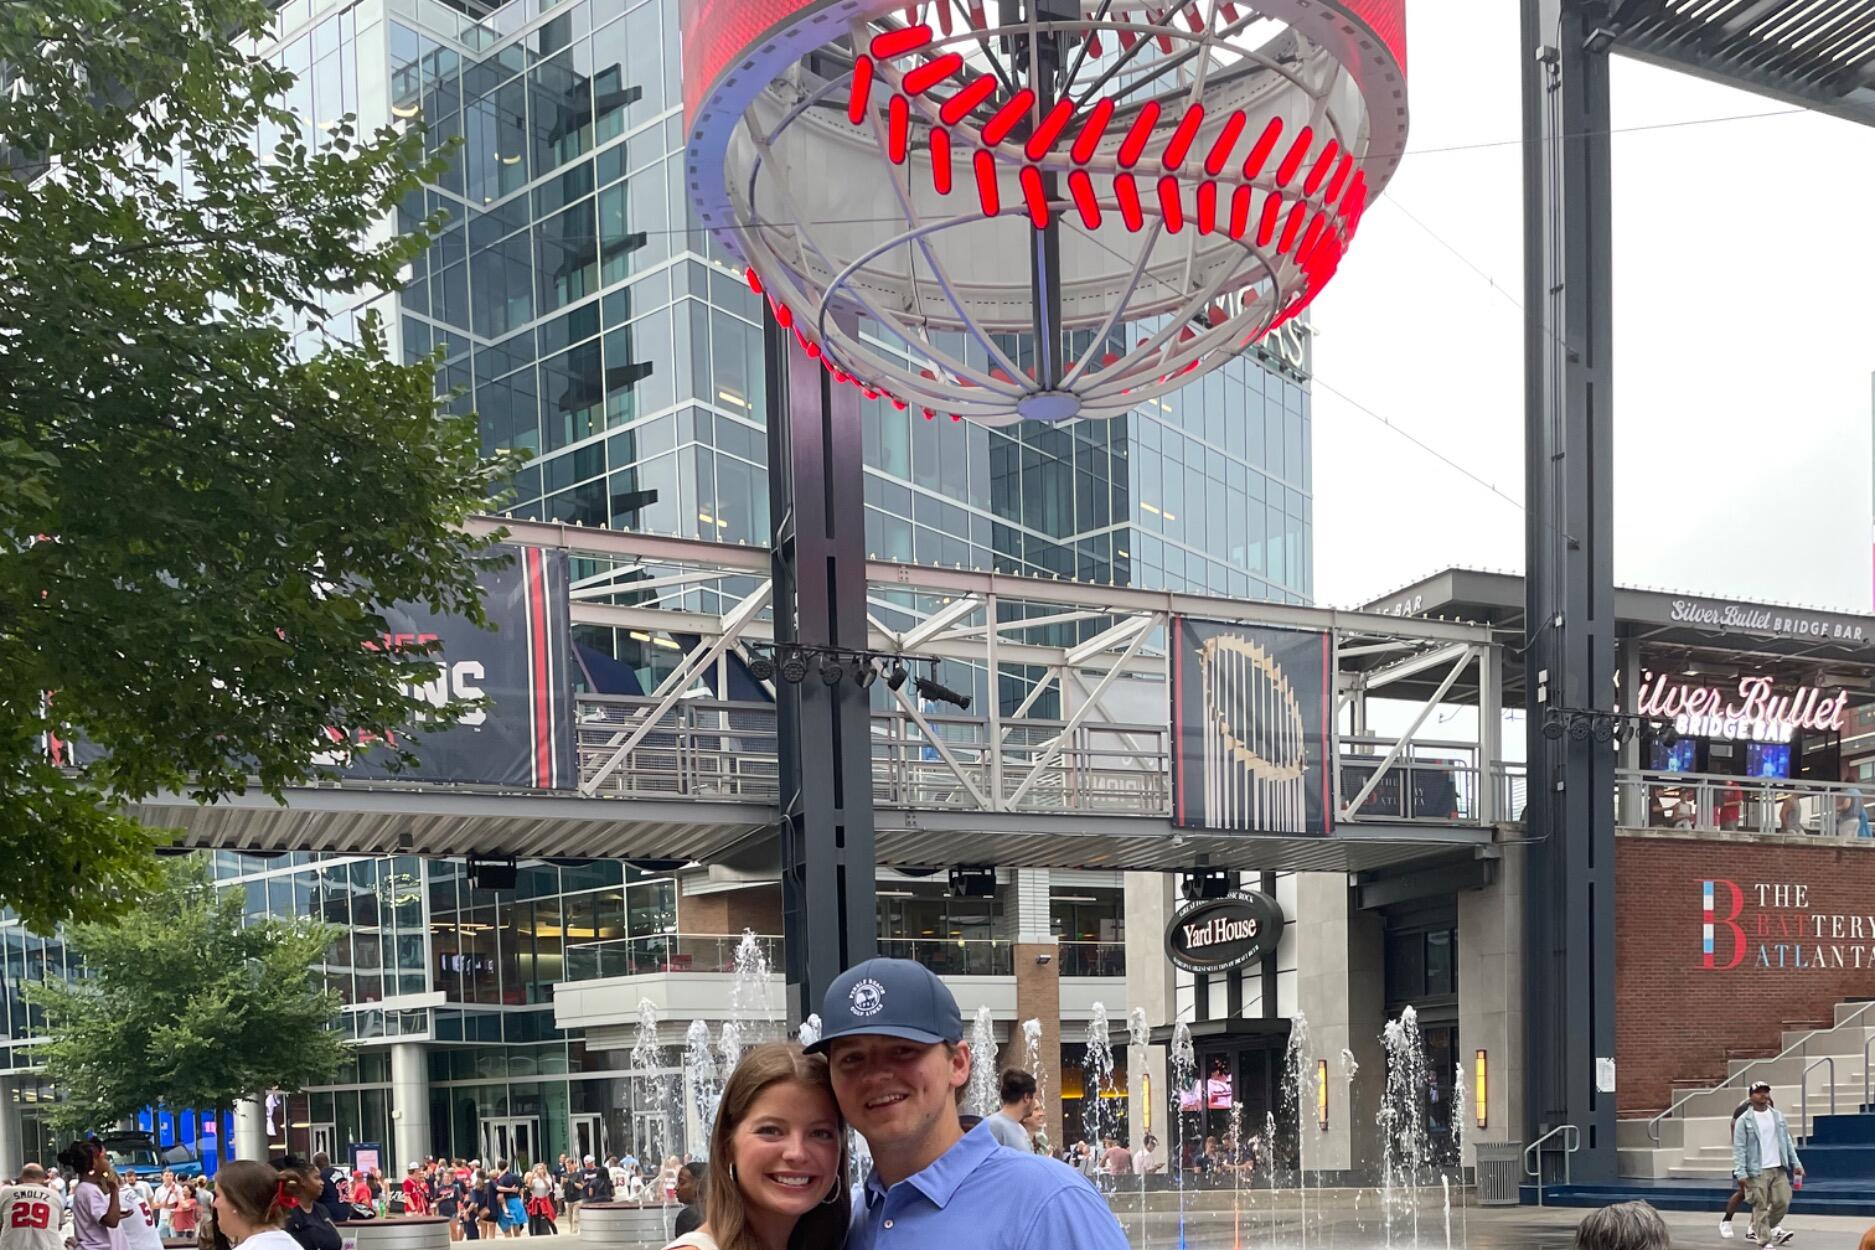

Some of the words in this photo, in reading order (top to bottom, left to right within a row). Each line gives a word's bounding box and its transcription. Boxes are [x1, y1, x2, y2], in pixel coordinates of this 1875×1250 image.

[1671, 600, 1719, 623] Silver
[1720, 605, 1771, 629] Bullet
[1773, 617, 1829, 636] BRIDGE
[1833, 624, 1862, 641] BAR
[1637, 672, 1724, 718] ilver
[1726, 676, 1848, 731] Bullet
[1675, 714, 1749, 738] BRIDGE
[1752, 721, 1794, 743] BAR
[1754, 883, 1809, 908] THE
[1183, 919, 1213, 949] Yard
[1213, 917, 1257, 944] House
[13, 1190, 51, 1201] SMOLTZ
[11, 1202, 51, 1230] 29
